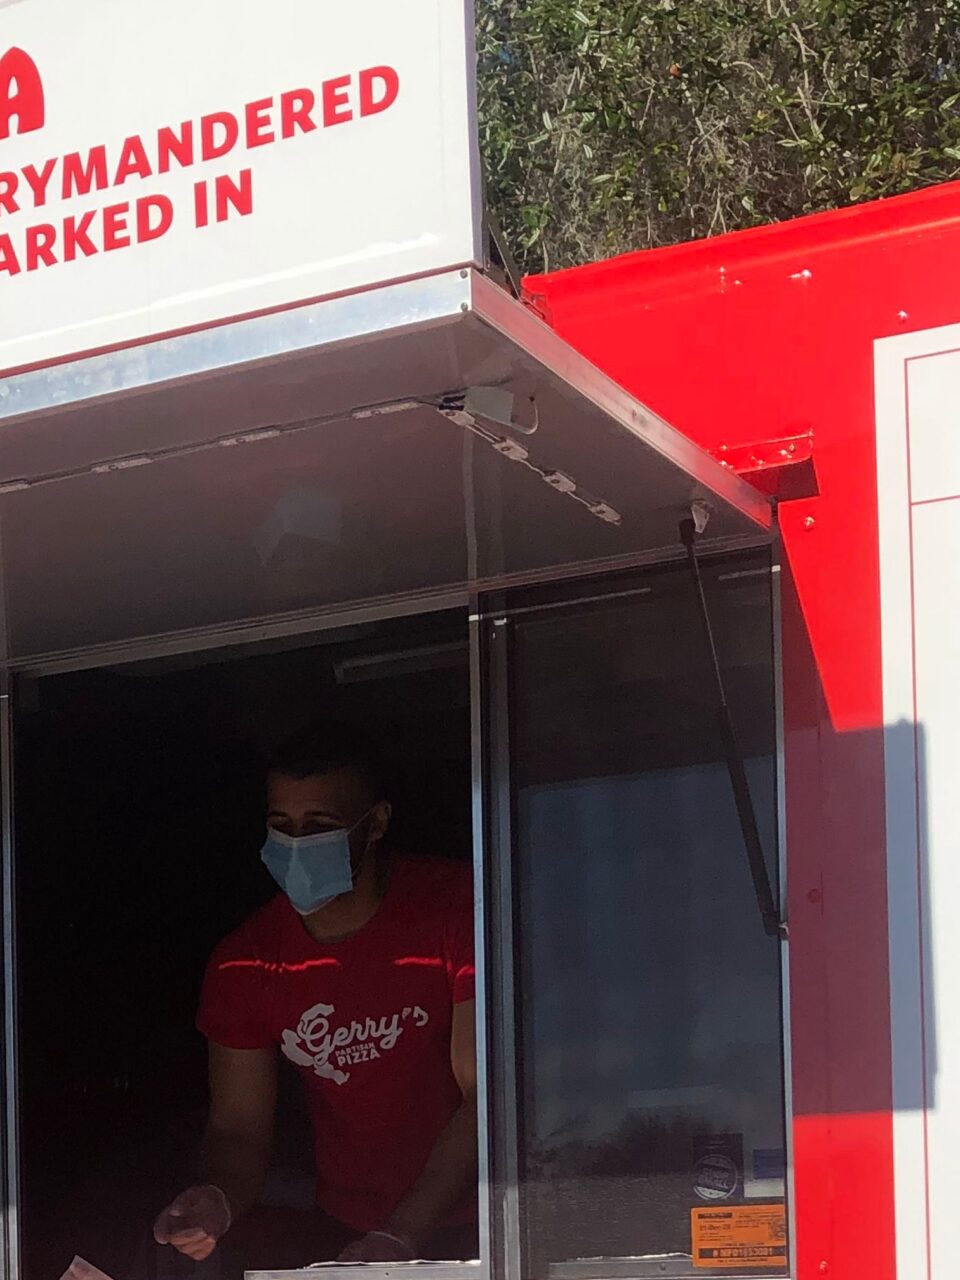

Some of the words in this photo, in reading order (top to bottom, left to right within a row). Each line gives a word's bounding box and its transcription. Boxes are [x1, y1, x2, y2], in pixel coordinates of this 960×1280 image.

[193, 168, 254, 228] IN
[297, 1006, 429, 1066] Gerry's
[337, 1048, 381, 1066] PIZZA
